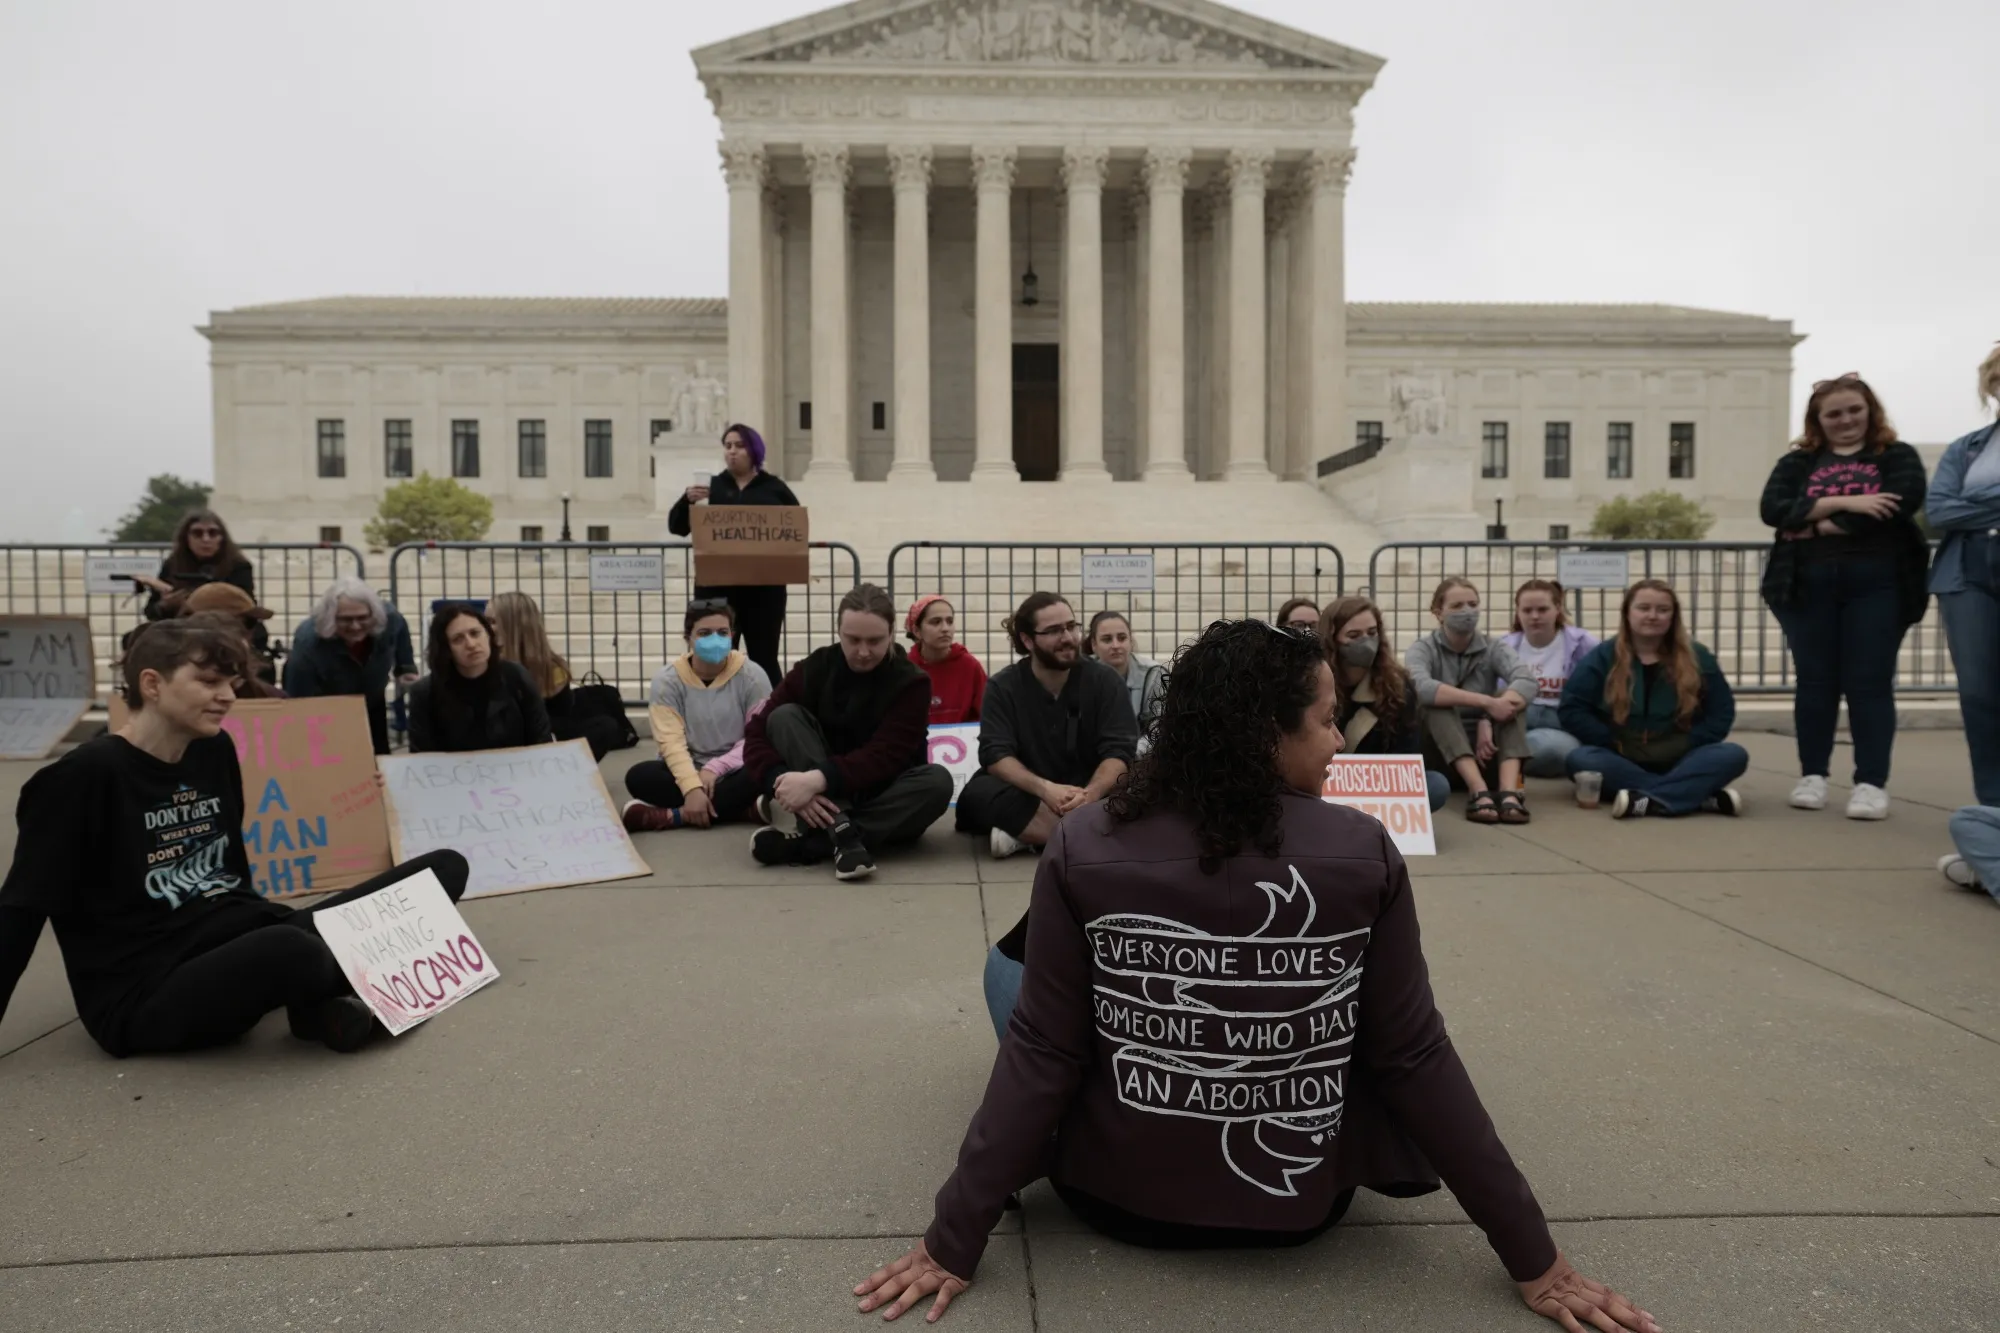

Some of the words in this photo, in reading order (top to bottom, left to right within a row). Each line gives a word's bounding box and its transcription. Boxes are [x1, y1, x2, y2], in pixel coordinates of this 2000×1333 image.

[702, 510, 768, 525] ABORTION
[780, 511, 794, 525] IS
[599, 560, 621, 569] AREA
[624, 560, 656, 569] CLOSED
[1091, 560, 1113, 568] AREA
[1116, 560, 1147, 568] CLOSED
[29, 631, 77, 667] AM
[400, 752, 580, 789] ABORTION
[1325, 762, 1424, 793] PROSECUTING
[144, 805, 190, 829] DON'T
[191, 797, 221, 820] GET
[172, 791, 198, 804] YOU
[257, 777, 290, 814] A
[469, 787, 522, 811] IS
[161, 828, 188, 841] WHAT
[188, 823, 211, 836] YOU
[241, 815, 328, 854] MAN
[403, 799, 608, 842] HEALTHCARE
[147, 845, 184, 865] DON'T
[504, 855, 548, 871] IS
[336, 906, 372, 932] YOU
[371, 887, 417, 922] ARE
[350, 916, 435, 966] WAKING
[1093, 931, 1239, 975] EVERYONE
[1256, 946, 1346, 975] LOVES
[371, 934, 484, 1011] VOLCANO
[1093, 993, 1206, 1047] SOMEONE
[1224, 1022, 1294, 1050] WHO
[1125, 1066, 1171, 1103] AN
[1184, 1070, 1344, 1111] ABORTION
